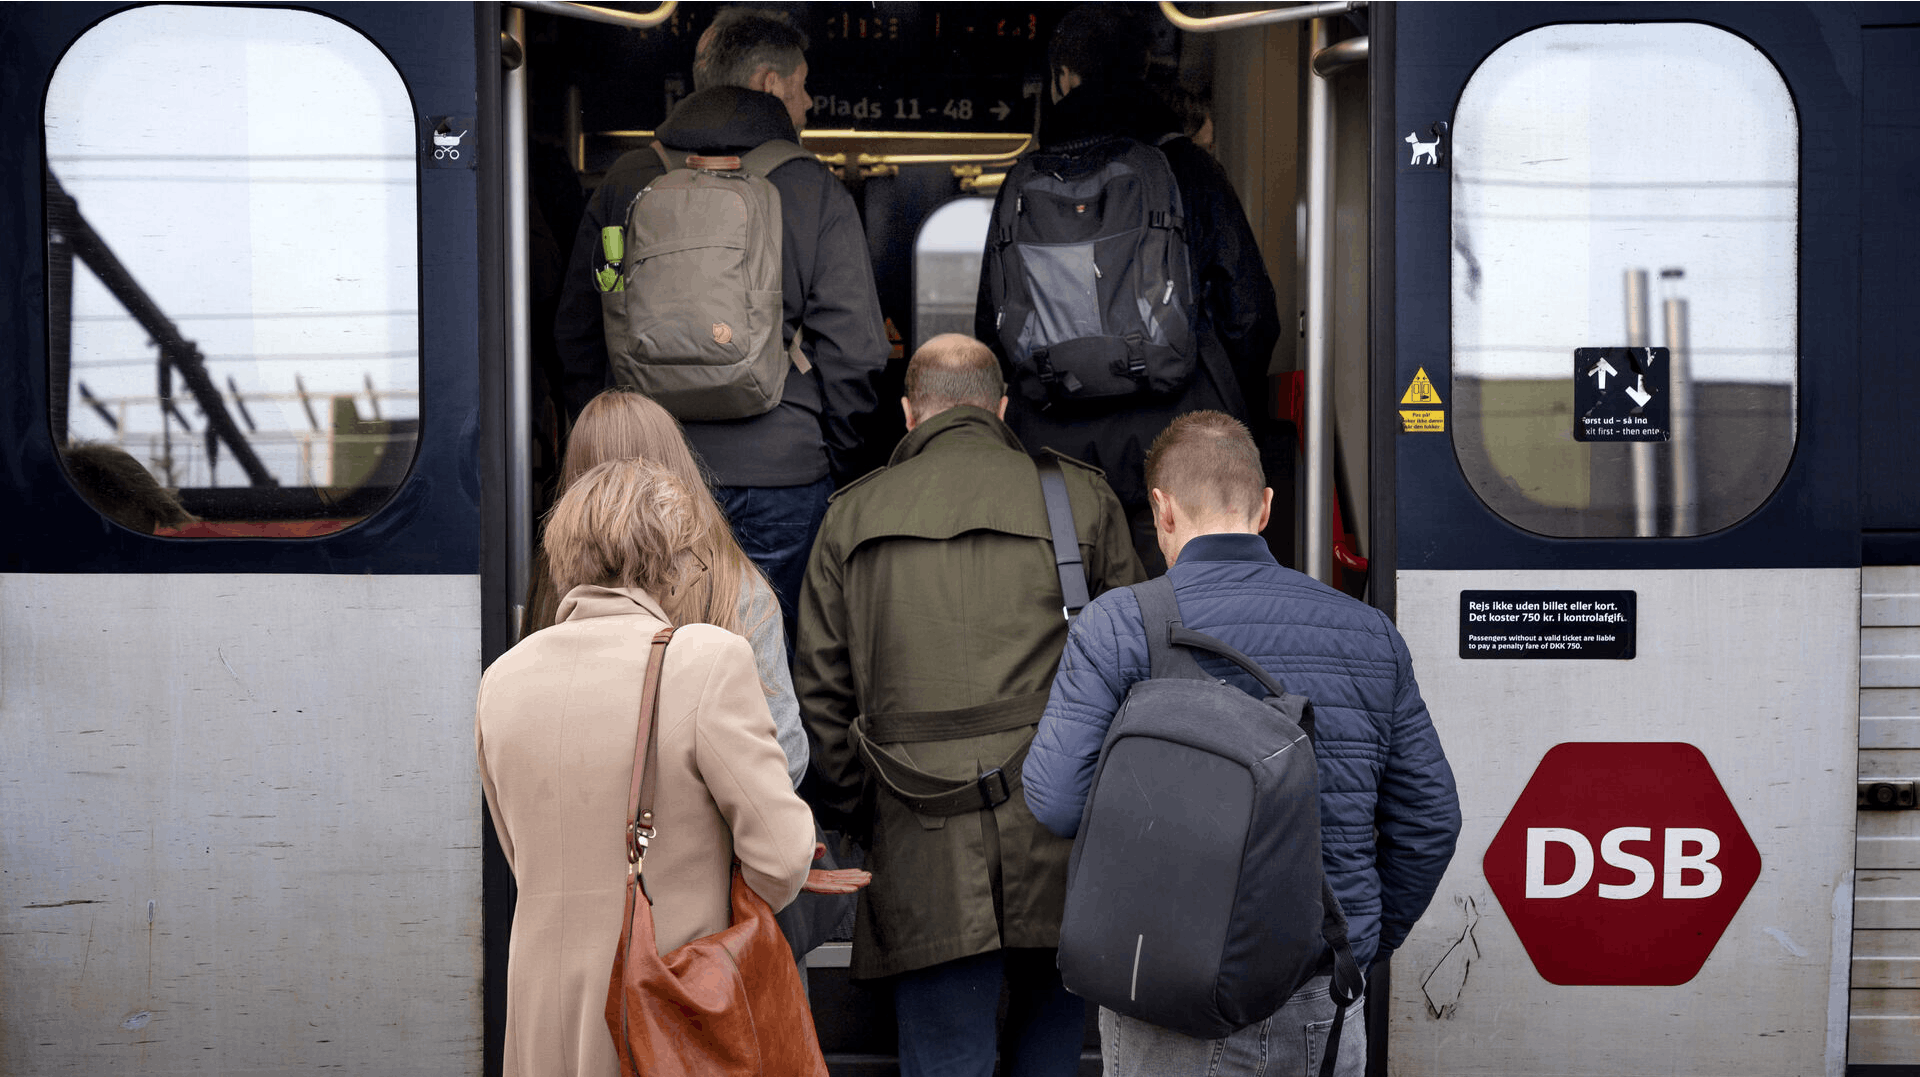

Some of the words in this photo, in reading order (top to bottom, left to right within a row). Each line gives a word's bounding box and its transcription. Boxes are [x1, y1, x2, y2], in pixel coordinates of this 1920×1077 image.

[813, 96, 881, 119] Plads
[895, 99, 921, 119] 11
[943, 99, 972, 120] 48
[1623, 416, 1632, 424] så
[1586, 427, 1595, 435] xit
[1598, 427, 1613, 435] first
[1623, 427, 1640, 435] then
[1470, 601, 1490, 612] Rejs
[1493, 601, 1513, 610] ikke
[1516, 601, 1539, 610] uden
[1543, 601, 1567, 610] billet
[1570, 601, 1592, 610] eller
[1595, 601, 1617, 610] kort.
[1469, 613, 1486, 622] Det
[1489, 613, 1520, 622] koster
[1522, 613, 1540, 622] 750
[1543, 613, 1554, 622] kr.
[1557, 613, 1561, 622] i
[1526, 642, 1539, 650] fare
[1541, 642, 1548, 650] of
[1526, 827, 1722, 899] DSB
